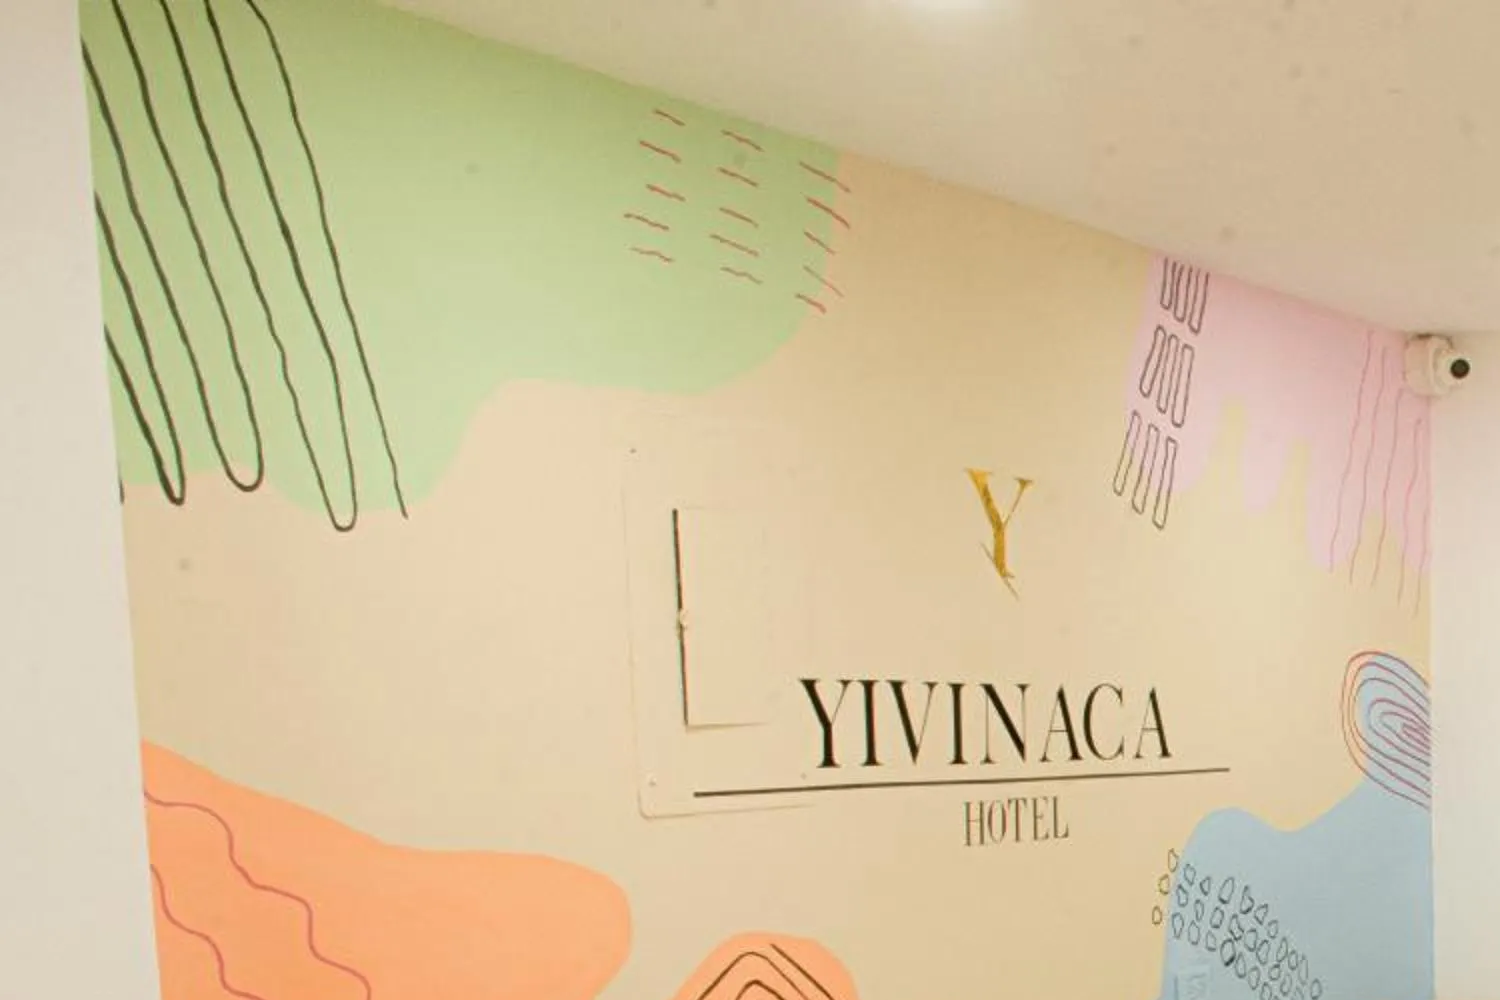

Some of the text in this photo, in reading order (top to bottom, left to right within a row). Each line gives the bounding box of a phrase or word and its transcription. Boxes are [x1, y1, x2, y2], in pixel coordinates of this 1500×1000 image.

[966, 468, 1034, 582] Y
[799, 678, 1173, 768] YIVINACA
[964, 796, 1070, 847] HOTEL
